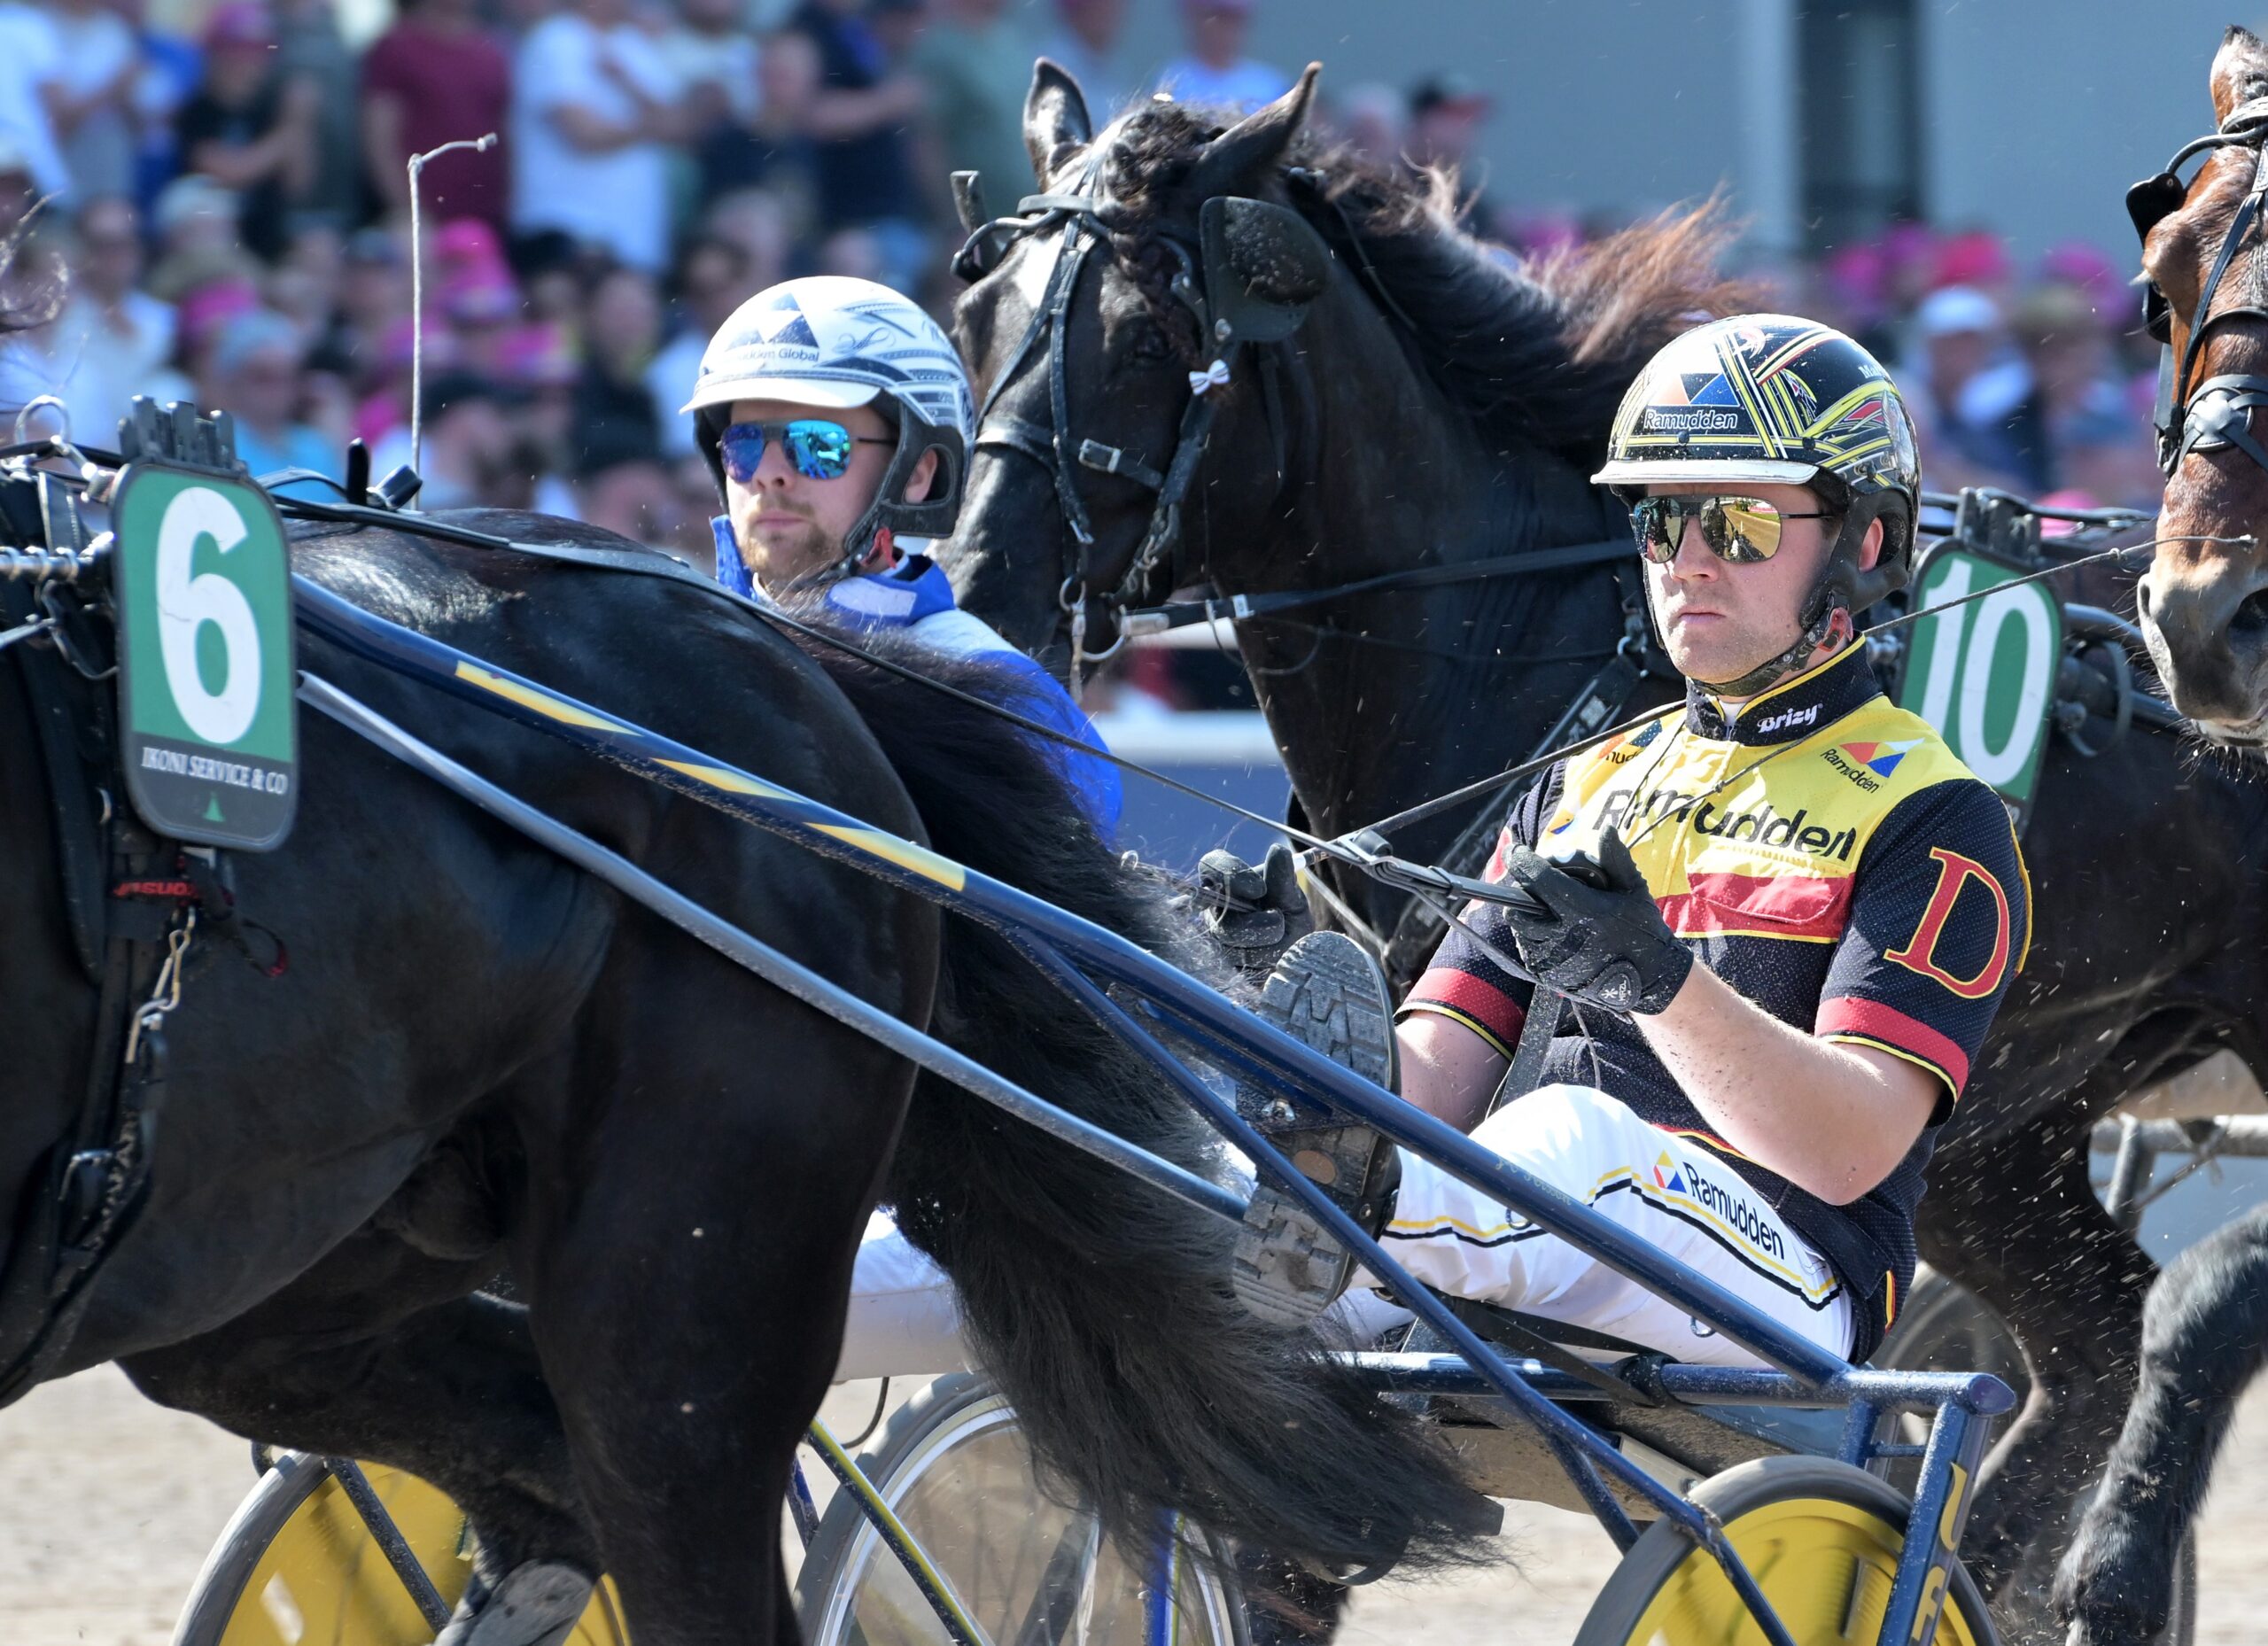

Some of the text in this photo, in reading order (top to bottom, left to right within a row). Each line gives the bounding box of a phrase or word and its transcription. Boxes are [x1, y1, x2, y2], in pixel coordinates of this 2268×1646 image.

[778, 347, 820, 362] Global
[1643, 408, 1738, 430] Ramudden
[155, 486, 261, 744] 6
[1920, 558, 2053, 787] 10
[141, 746, 289, 796] IKONI SERVICE & CO
[1820, 748, 1879, 794] Ramudden
[1883, 845, 2010, 999] D
[1682, 1161, 1785, 1260] Ramudden
